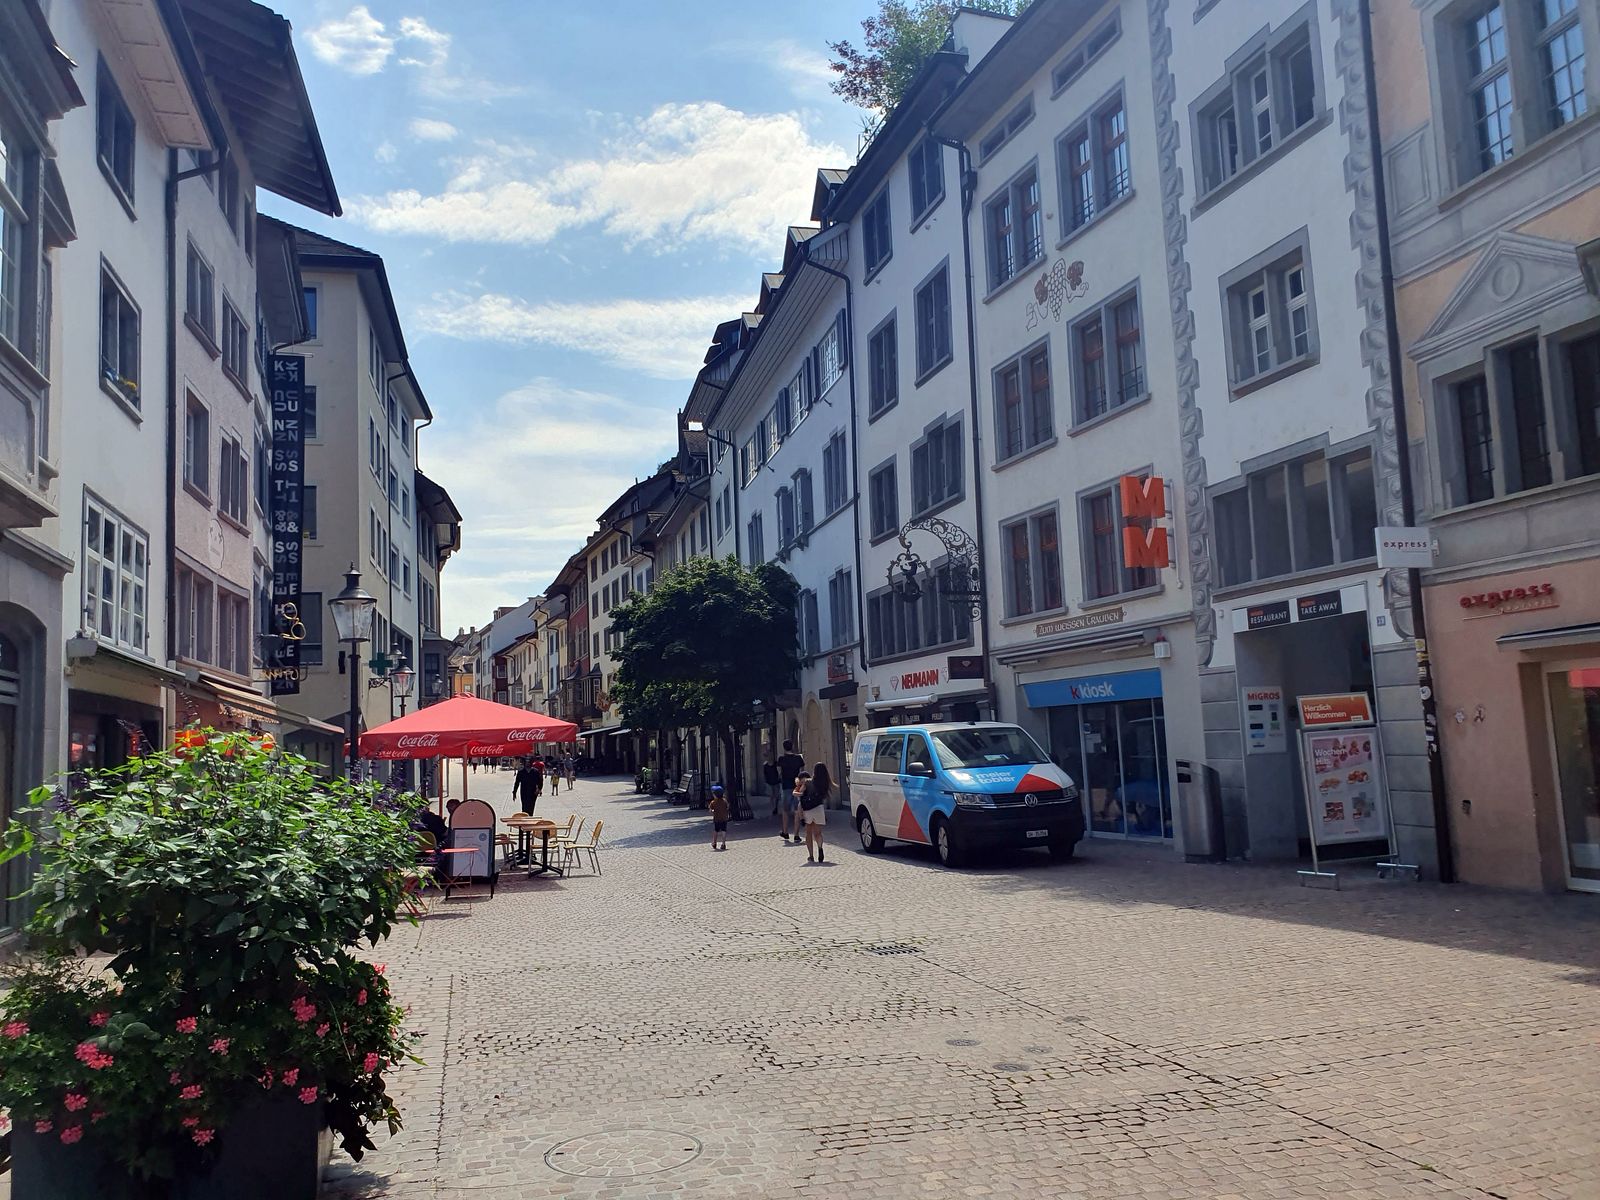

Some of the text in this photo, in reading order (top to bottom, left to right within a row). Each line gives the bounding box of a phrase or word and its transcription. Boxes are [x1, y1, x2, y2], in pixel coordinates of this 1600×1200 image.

[1383, 539, 1428, 550] express
[1459, 582, 1554, 609] express
[1250, 610, 1288, 625] RESTAURANT
[1300, 605, 1317, 615] TAKE
[1318, 601, 1339, 612] AWAY
[901, 669, 939, 690] NEUMANN
[1079, 681, 1115, 699] kiosk
[1303, 703, 1332, 712] Herzlich
[1305, 710, 1347, 720] Willkommen
[976, 771, 1012, 779] meier
[977, 776, 1016, 785] tobler
